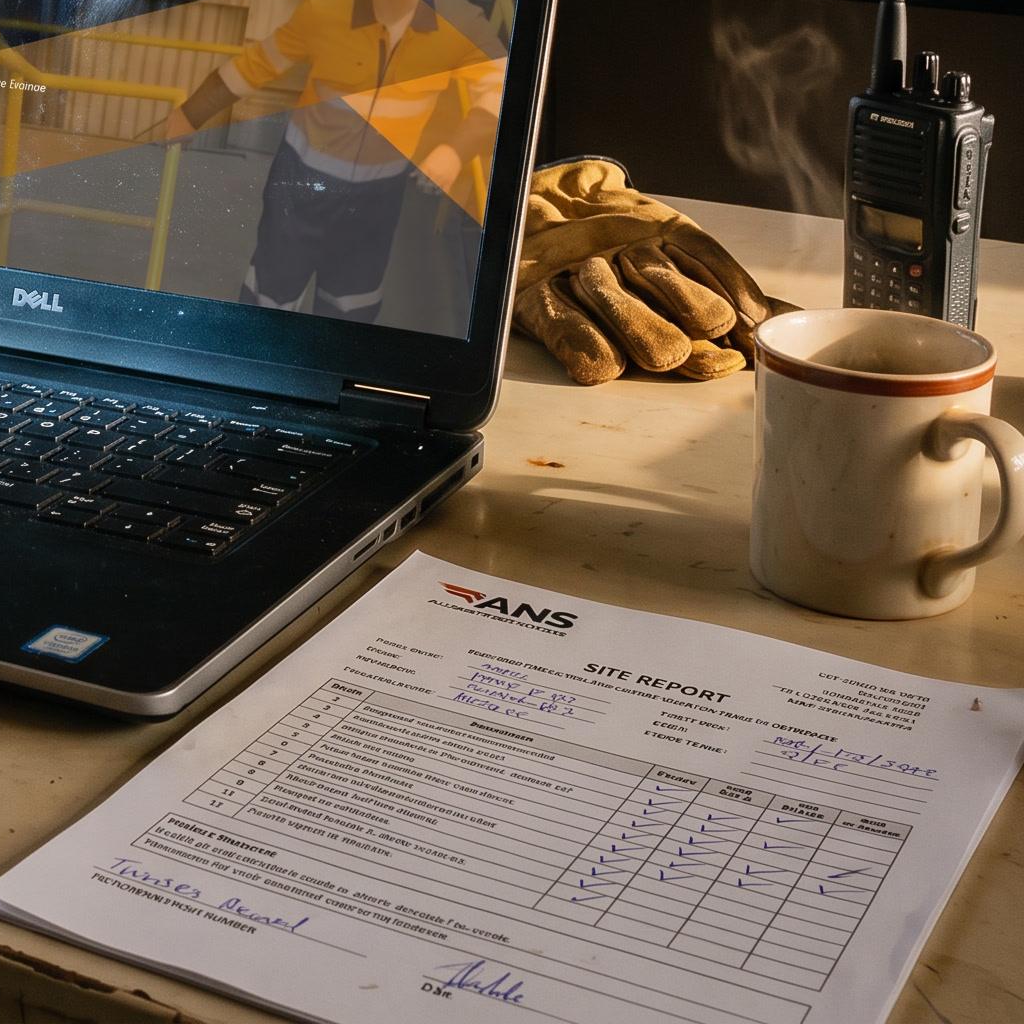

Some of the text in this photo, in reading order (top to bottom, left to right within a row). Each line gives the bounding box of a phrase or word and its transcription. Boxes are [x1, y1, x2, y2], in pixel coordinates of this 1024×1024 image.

[12, 287, 64, 313] DELL
[473, 596, 579, 629] ANS
[583, 662, 633, 681] SITE
[636, 673, 731, 703] REPORT
